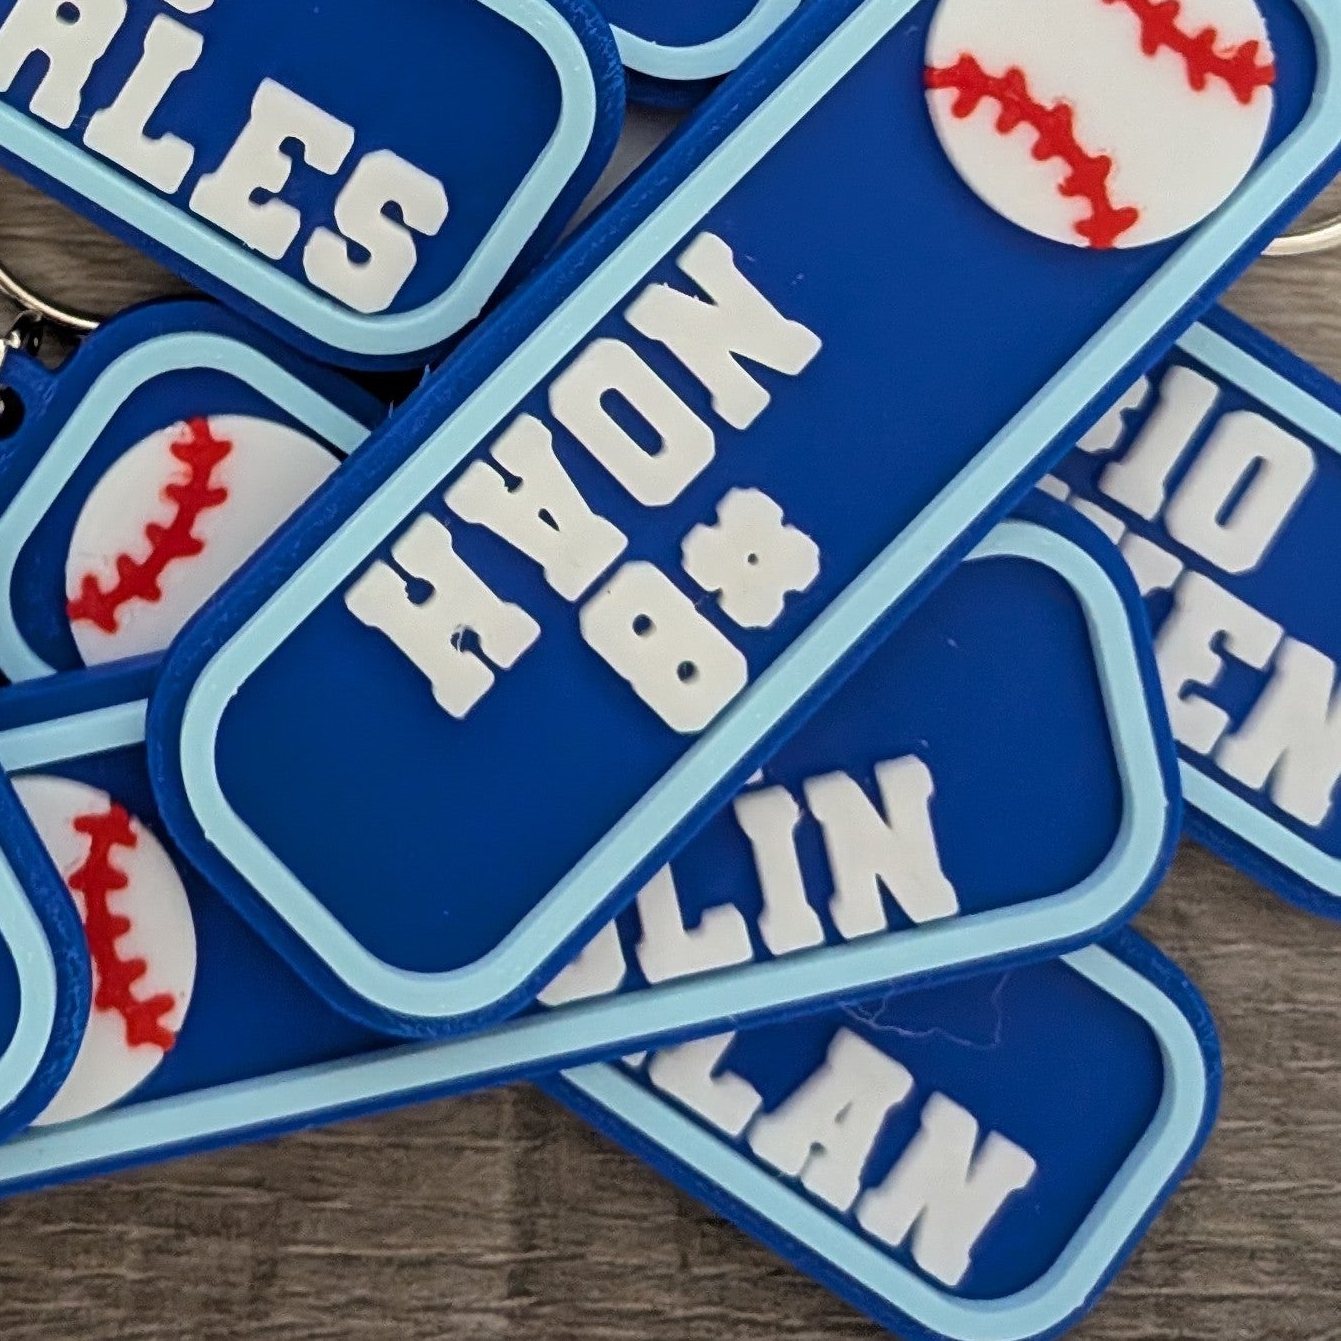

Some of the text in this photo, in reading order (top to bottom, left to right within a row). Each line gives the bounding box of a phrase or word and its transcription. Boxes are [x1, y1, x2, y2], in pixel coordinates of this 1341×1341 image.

[345, 231, 822, 719] NOAH
[1076, 365, 1315, 575] 10
[579, 488, 821, 734] #8
[536, 754, 959, 1007] LIN
[621, 1026, 1037, 1287] LAN
